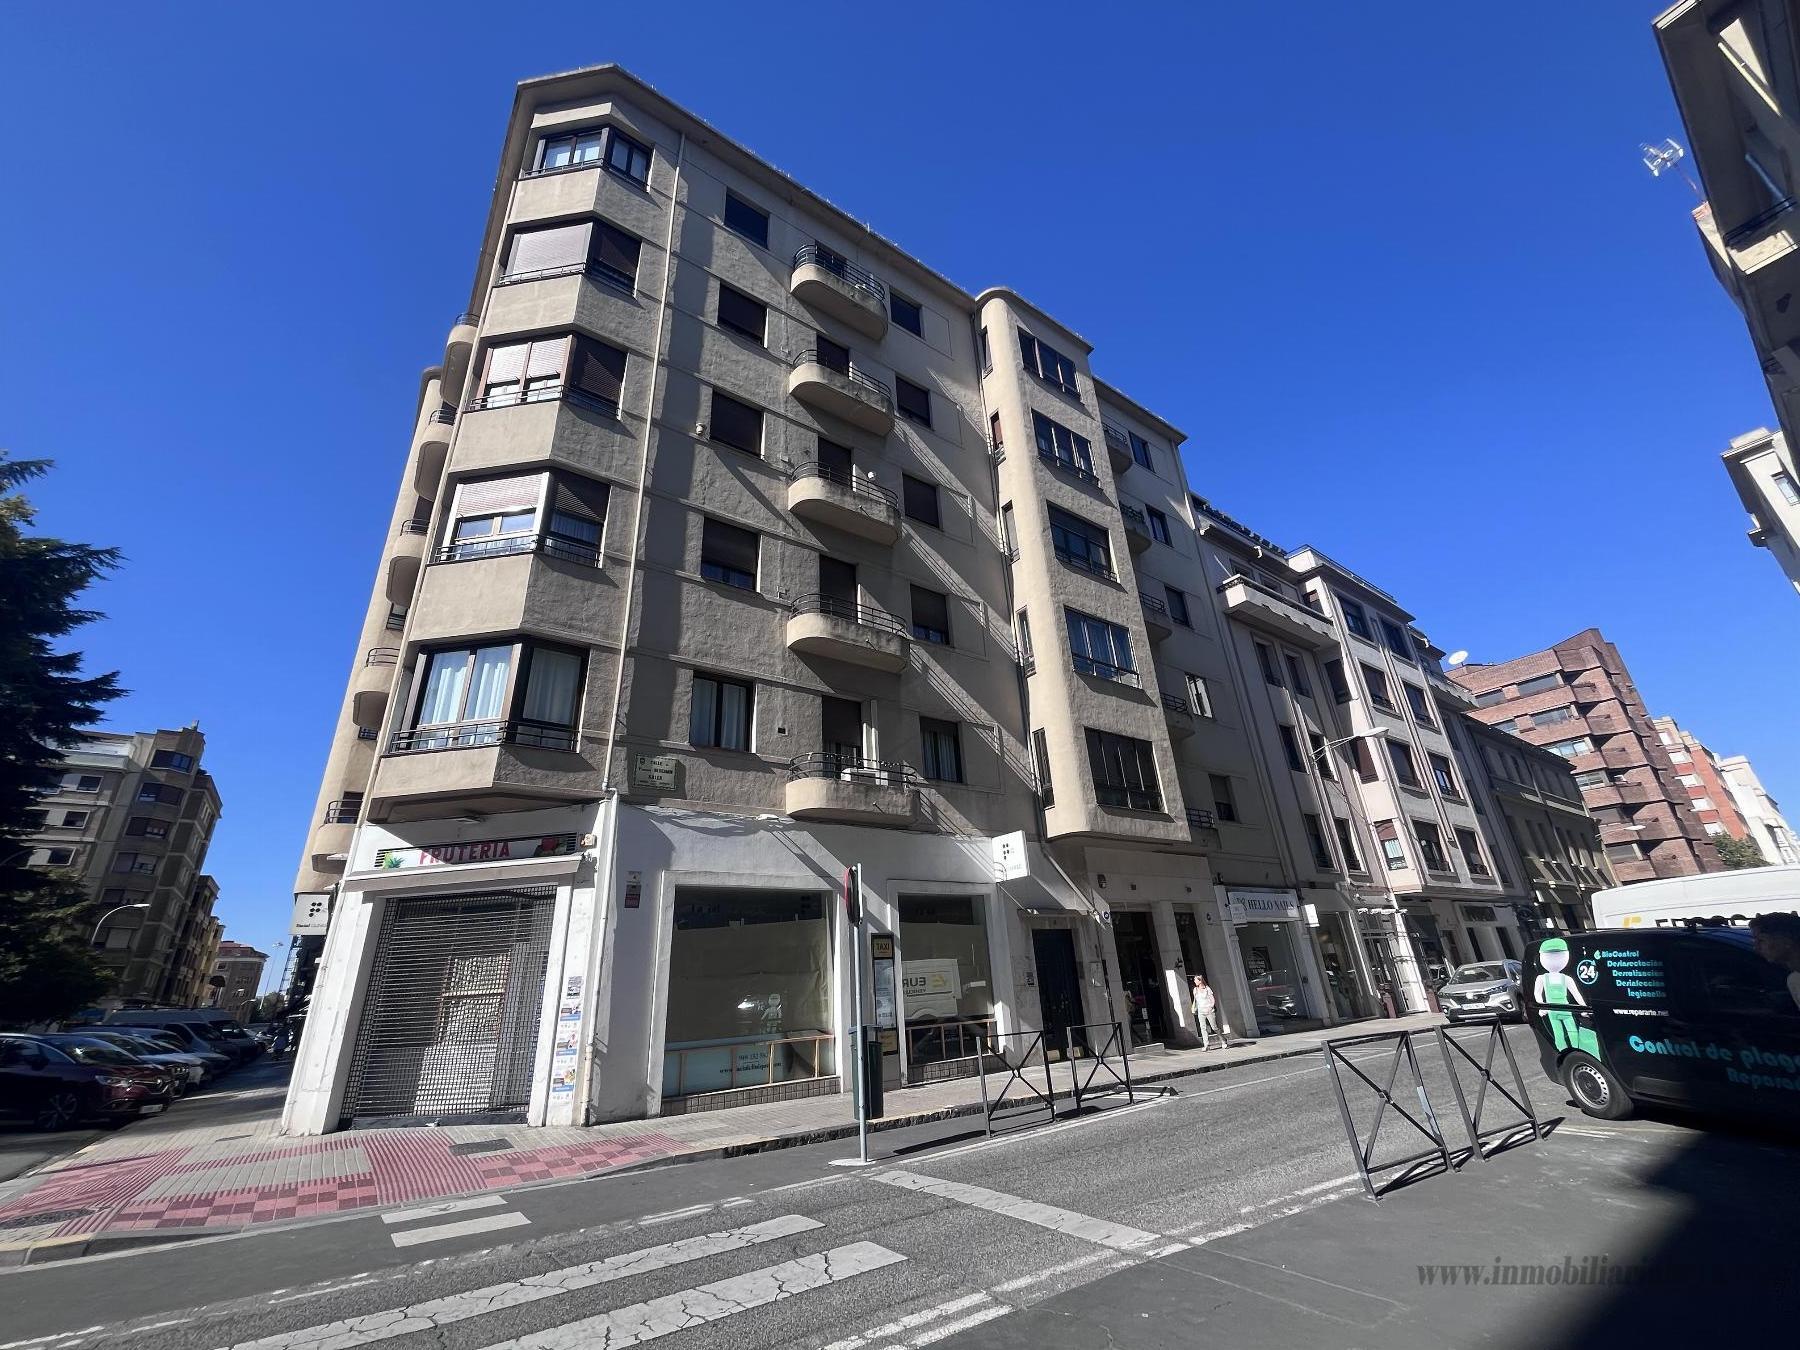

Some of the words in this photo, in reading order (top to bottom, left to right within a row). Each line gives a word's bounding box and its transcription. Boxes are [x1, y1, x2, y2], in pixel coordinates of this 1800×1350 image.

[418, 841, 509, 865] FRUTERIA
[1247, 899, 1273, 911] HELLO
[876, 943, 890, 951] TAXI
[1580, 965, 1596, 979] 24
[1629, 1035, 1700, 1058] Control
[1706, 1042, 1732, 1061] de
